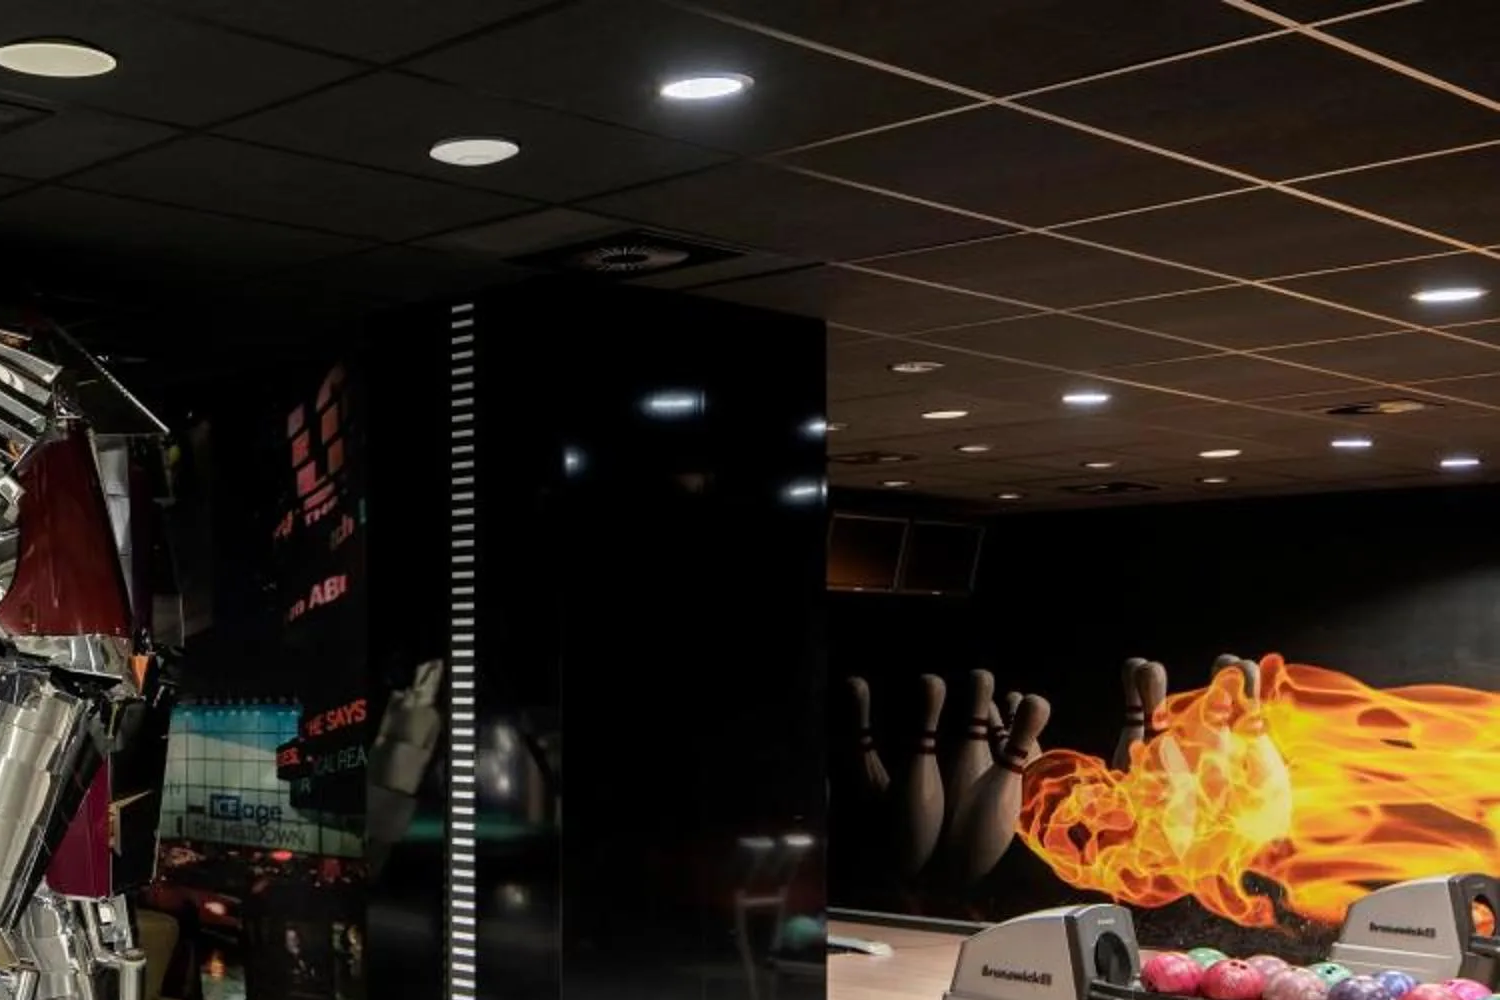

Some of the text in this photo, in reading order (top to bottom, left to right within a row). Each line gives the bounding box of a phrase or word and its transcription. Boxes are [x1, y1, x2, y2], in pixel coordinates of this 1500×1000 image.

[325, 698, 367, 732] SAYS
[213, 798, 282, 826] ICE age
[981, 963, 1041, 985] Brunswick
